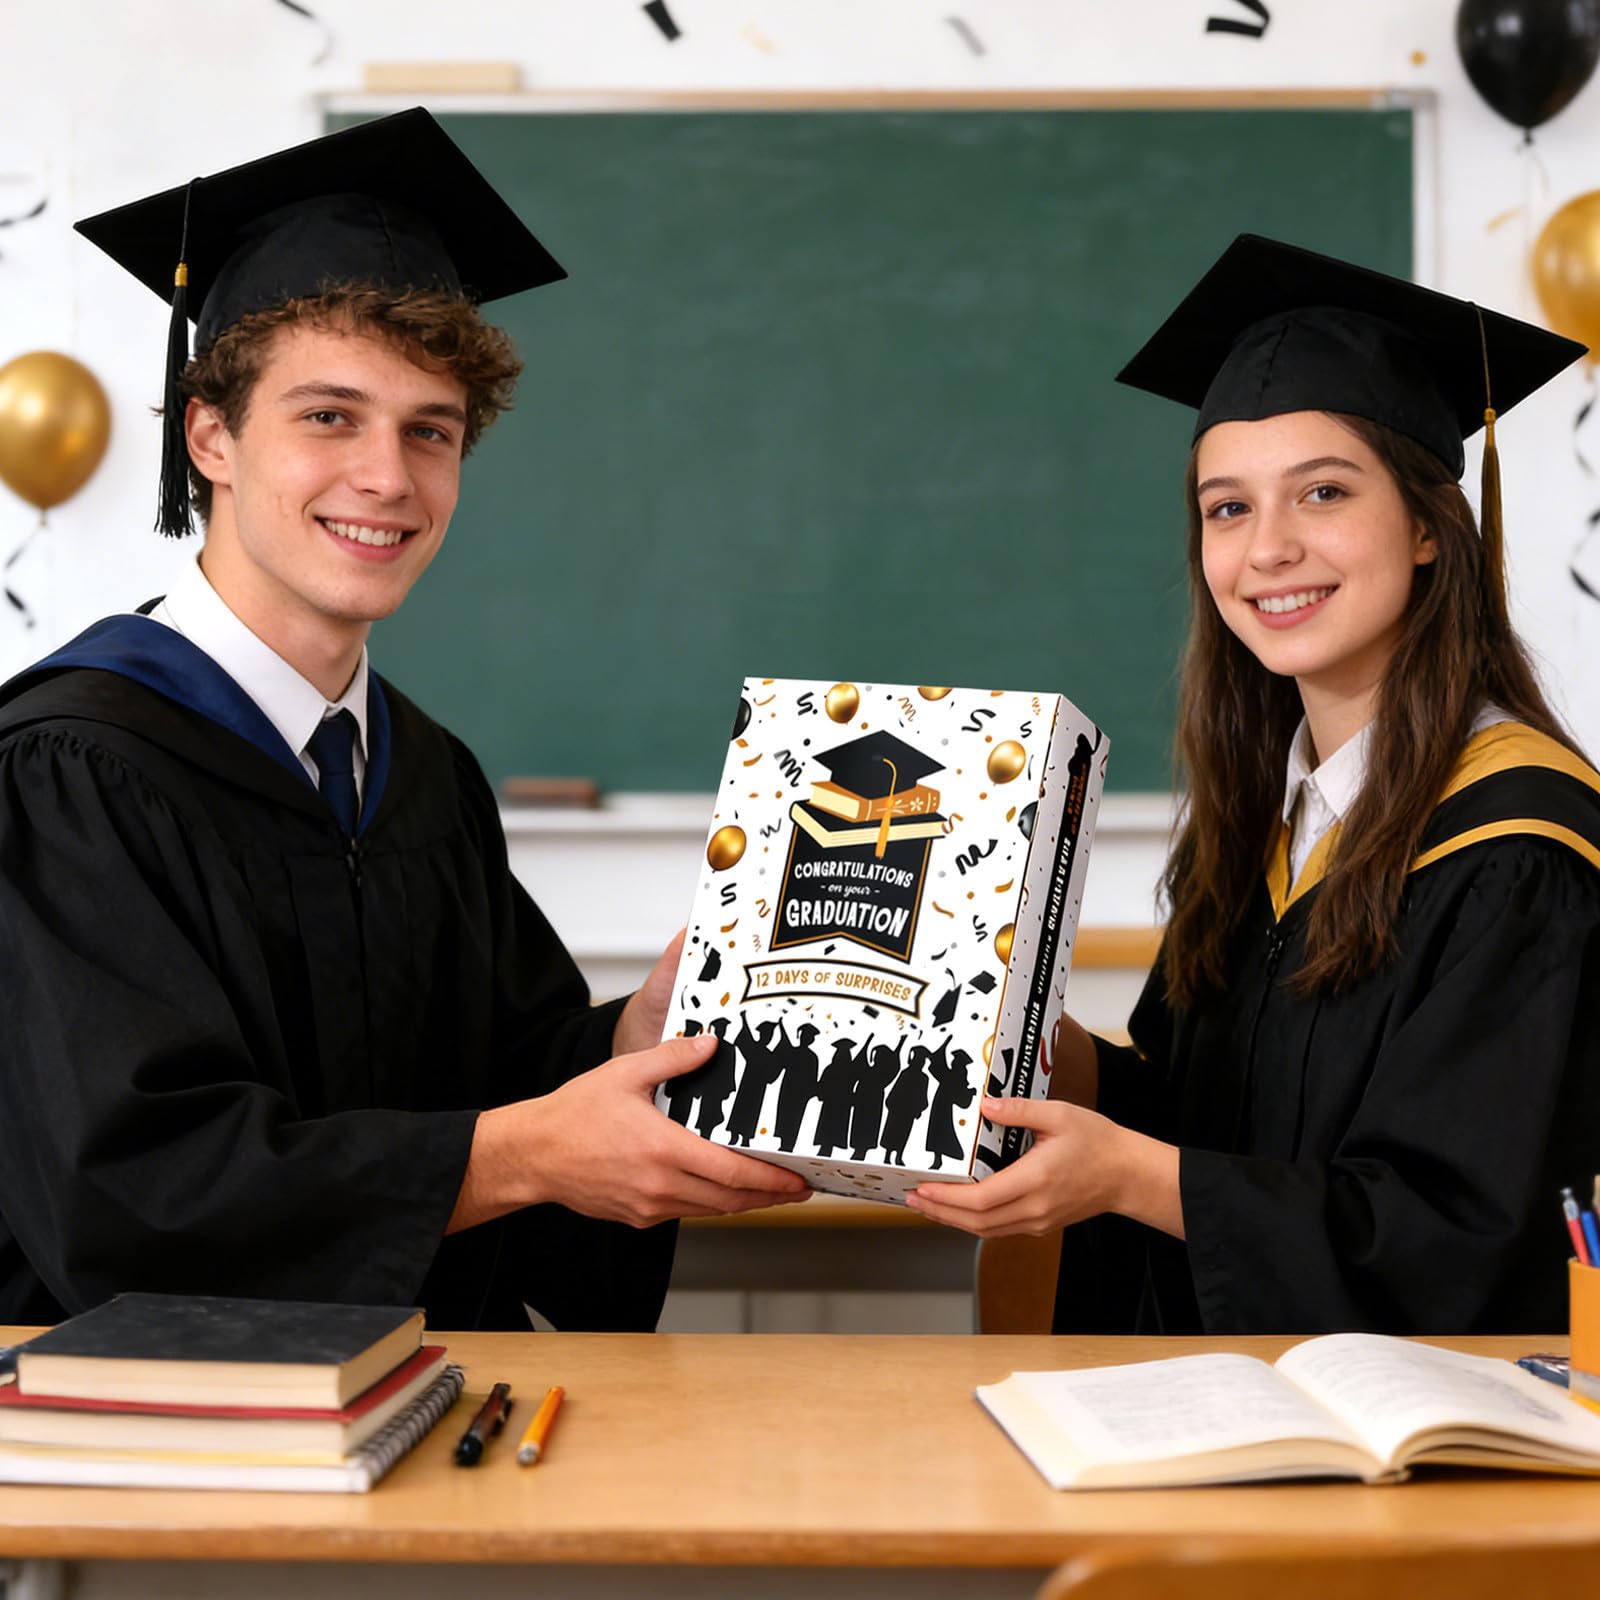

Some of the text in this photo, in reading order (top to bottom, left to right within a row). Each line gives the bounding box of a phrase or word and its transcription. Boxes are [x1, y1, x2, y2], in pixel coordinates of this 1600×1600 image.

[794, 861, 914, 888] CONGRATULATIONS
[828, 884, 871, 898] on your
[785, 898, 910, 938] GRADUATION
[756, 970, 911, 1001] 12 DAYS OF SURPRISES
